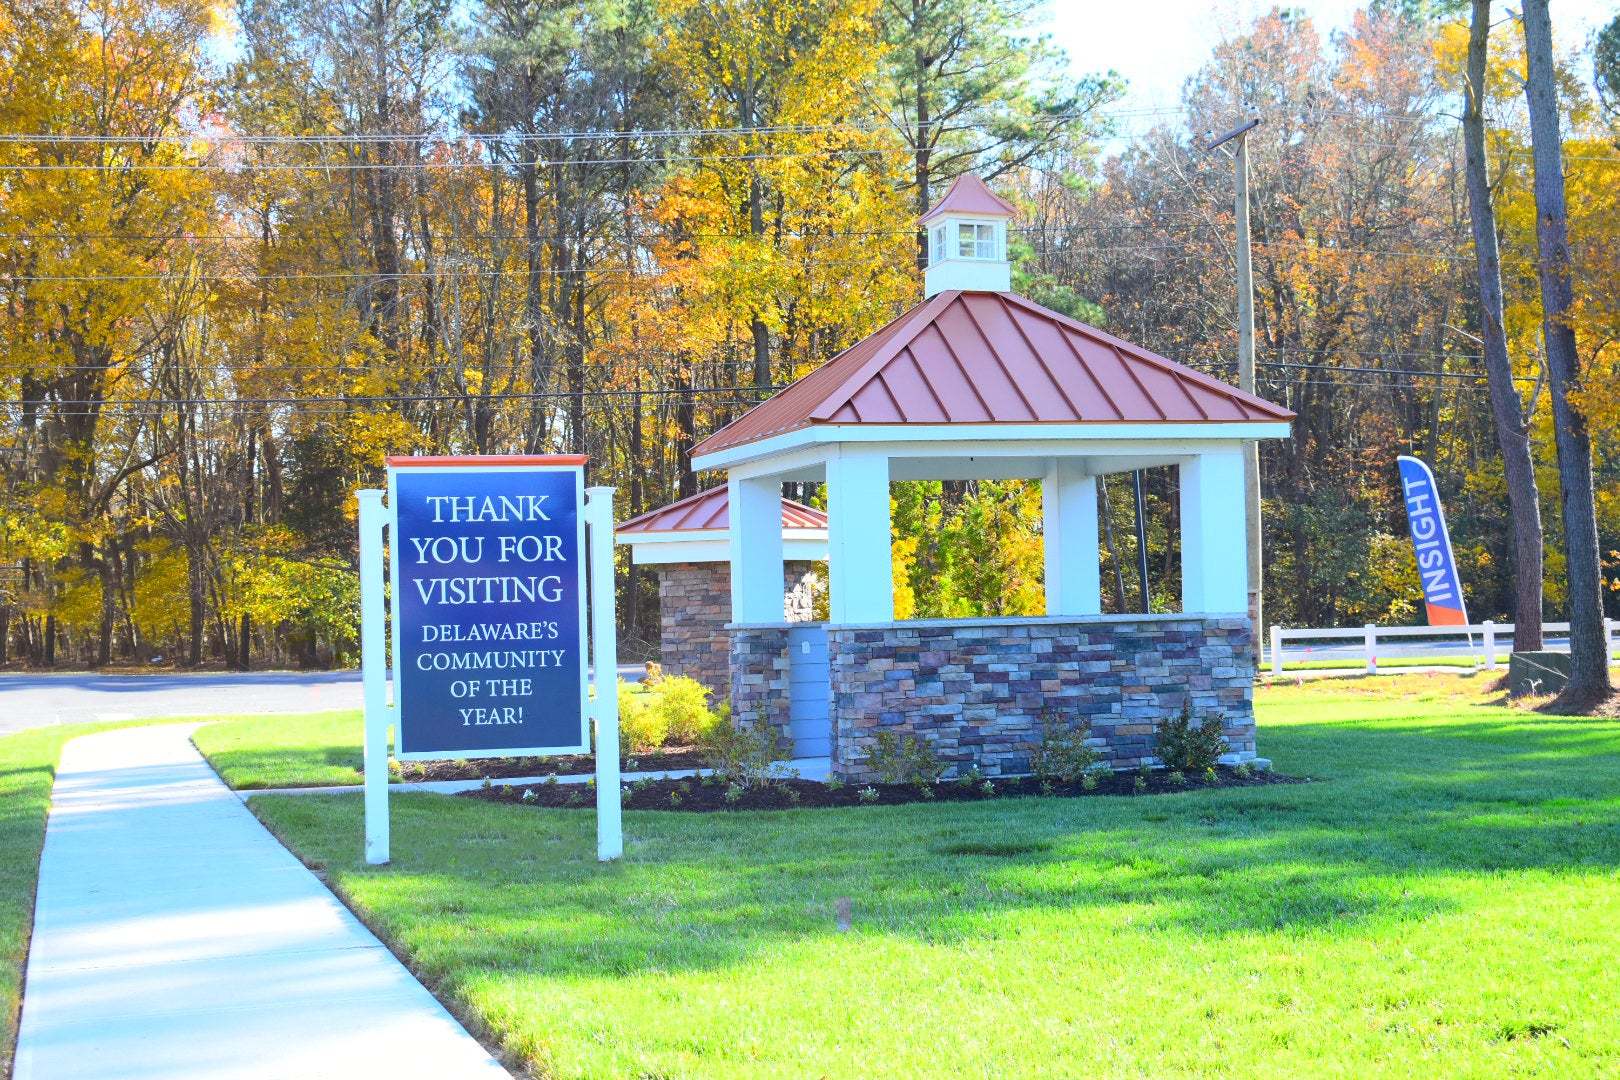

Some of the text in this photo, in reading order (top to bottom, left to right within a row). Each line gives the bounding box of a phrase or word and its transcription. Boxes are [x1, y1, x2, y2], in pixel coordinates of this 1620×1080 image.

[426, 495, 551, 523] THANK
[410, 535, 567, 564] YOU FOR
[1404, 477, 1452, 602] INSIGHT
[412, 575, 563, 605] VISITING
[422, 621, 559, 642] DELAWARE'S
[417, 649, 566, 671] COMMUNITY
[450, 678, 533, 698] OF THE
[459, 707, 523, 726] YEAR!
